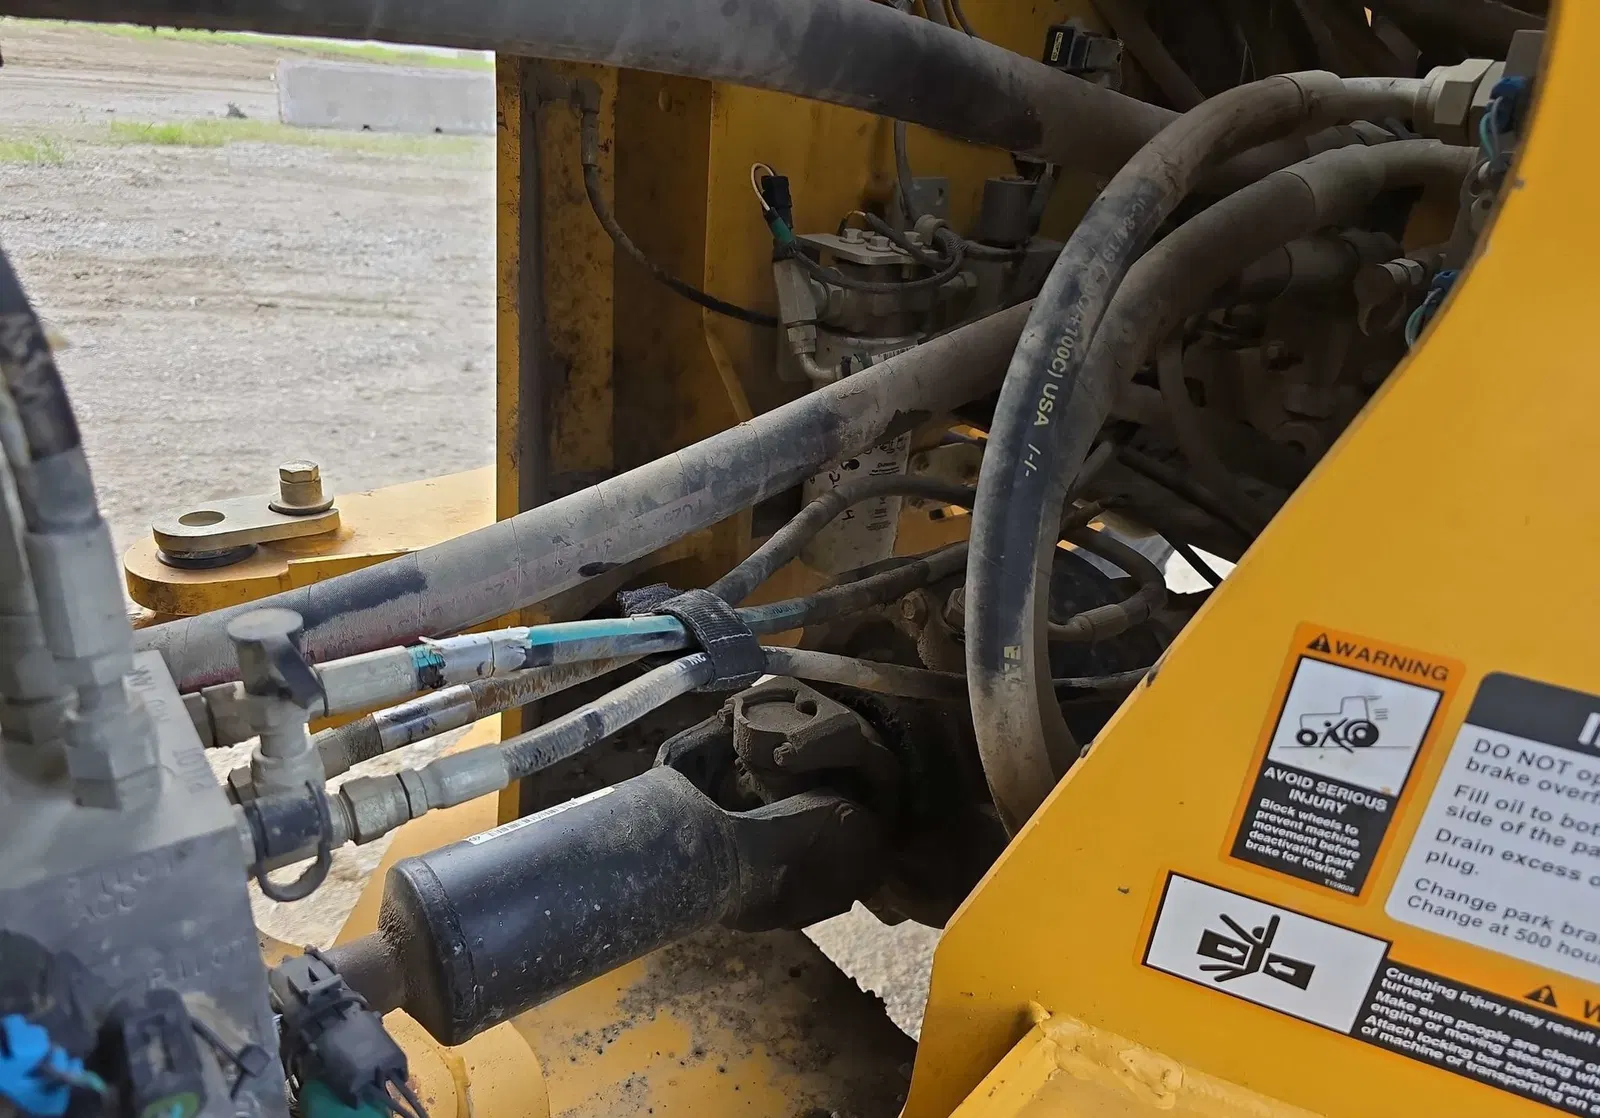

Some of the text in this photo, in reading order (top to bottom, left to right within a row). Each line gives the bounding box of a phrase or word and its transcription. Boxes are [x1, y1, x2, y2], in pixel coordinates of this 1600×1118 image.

[1034, 382, 1058, 426] USA
[1335, 640, 1450, 681] WARNING
[1578, 712, 1600, 747] I
[1465, 756, 1530, 785] brake
[1474, 738, 1510, 759] DO
[1517, 750, 1573, 775] NOT
[1264, 767, 1388, 812] AVOID SERIOUS
[1288, 788, 1347, 814] INJURY
[1453, 784, 1489, 805] Fill
[1495, 799, 1524, 815] oil
[1530, 806, 1552, 822] to
[1255, 810, 1360, 848] prevent machine
[1260, 798, 1359, 836] Block wheels to
[1445, 804, 1493, 827] side
[1500, 820, 1526, 835] of
[1529, 826, 1566, 847] the
[1245, 839, 1346, 879] brake for towing.
[1249, 830, 1356, 870] deactivating park
[1252, 820, 1360, 860] movement before
[1435, 827, 1494, 856] Drain
[1501, 850, 1581, 881] excess
[1425, 850, 1479, 876] plug.
[1407, 895, 1483, 928] Change
[1488, 921, 1510, 936] at
[1514, 928, 1553, 949] 500
[1414, 877, 1497, 912] Change
[1502, 906, 1554, 930] park
[1381, 978, 1435, 1005] turned.
[1386, 967, 1458, 1001] Crushing
[1459, 991, 1507, 1016] injury
[1507, 1008, 1545, 1029] may
[1545, 1021, 1596, 1045] result
[1370, 1002, 1423, 1026] engine
[1424, 1021, 1443, 1033] or
[1444, 1027, 1504, 1056] moving
[1505, 1048, 1573, 1079] steering
[1375, 990, 1416, 1013] Make
[1418, 1007, 1454, 1025] sure
[1455, 1019, 1511, 1044] people
[1512, 1039, 1540, 1054] are
[1542, 1048, 1584, 1068] clear
[1361, 1025, 1378, 1037] of
[1379, 1031, 1444, 1059] machine
[1445, 1054, 1464, 1067] or
[1466, 1060, 1563, 1103] transporting
[1565, 1096, 1588, 1110] on
[1365, 1014, 1415, 1039] Attach
[1417, 1031, 1474, 1060] locking
[1475, 1051, 1504, 1069] bar
[1505, 1061, 1557, 1088] before
